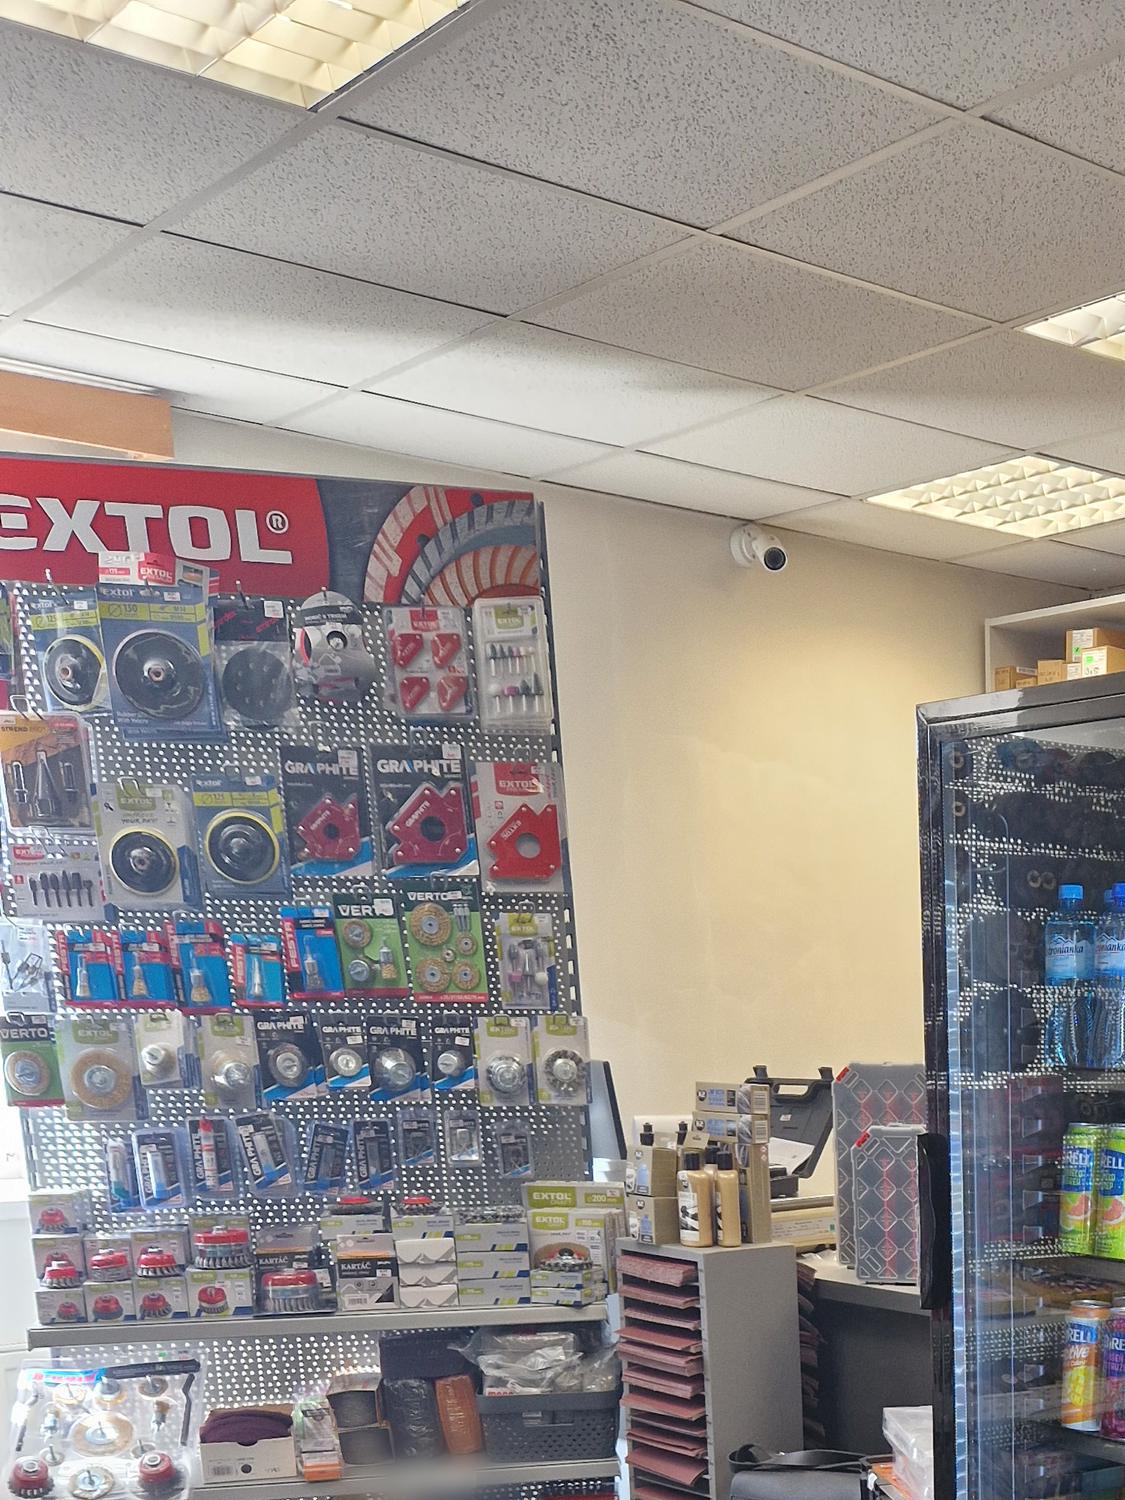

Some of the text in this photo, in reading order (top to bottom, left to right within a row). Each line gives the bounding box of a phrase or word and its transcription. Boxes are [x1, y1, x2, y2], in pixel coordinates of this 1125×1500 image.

[0, 494, 292, 564] EXTOL
[141, 566, 173, 578] EXTOL
[285, 760, 358, 776] GRAPHITE
[377, 758, 461, 775] GRAPHITE
[257, 1020, 305, 1031] GRAPHITE
[322, 1025, 361, 1034] GRAPHITE
[370, 1025, 417, 1036] GRAPHITE
[434, 1026, 470, 1035] GRAPHITE
[0, 1027, 48, 1039] VERTO
[533, 1191, 607, 1202] EXTOL 200
[535, 1215, 565, 1224] EXTOL
[340, 1260, 372, 1271] KARTÁČ
